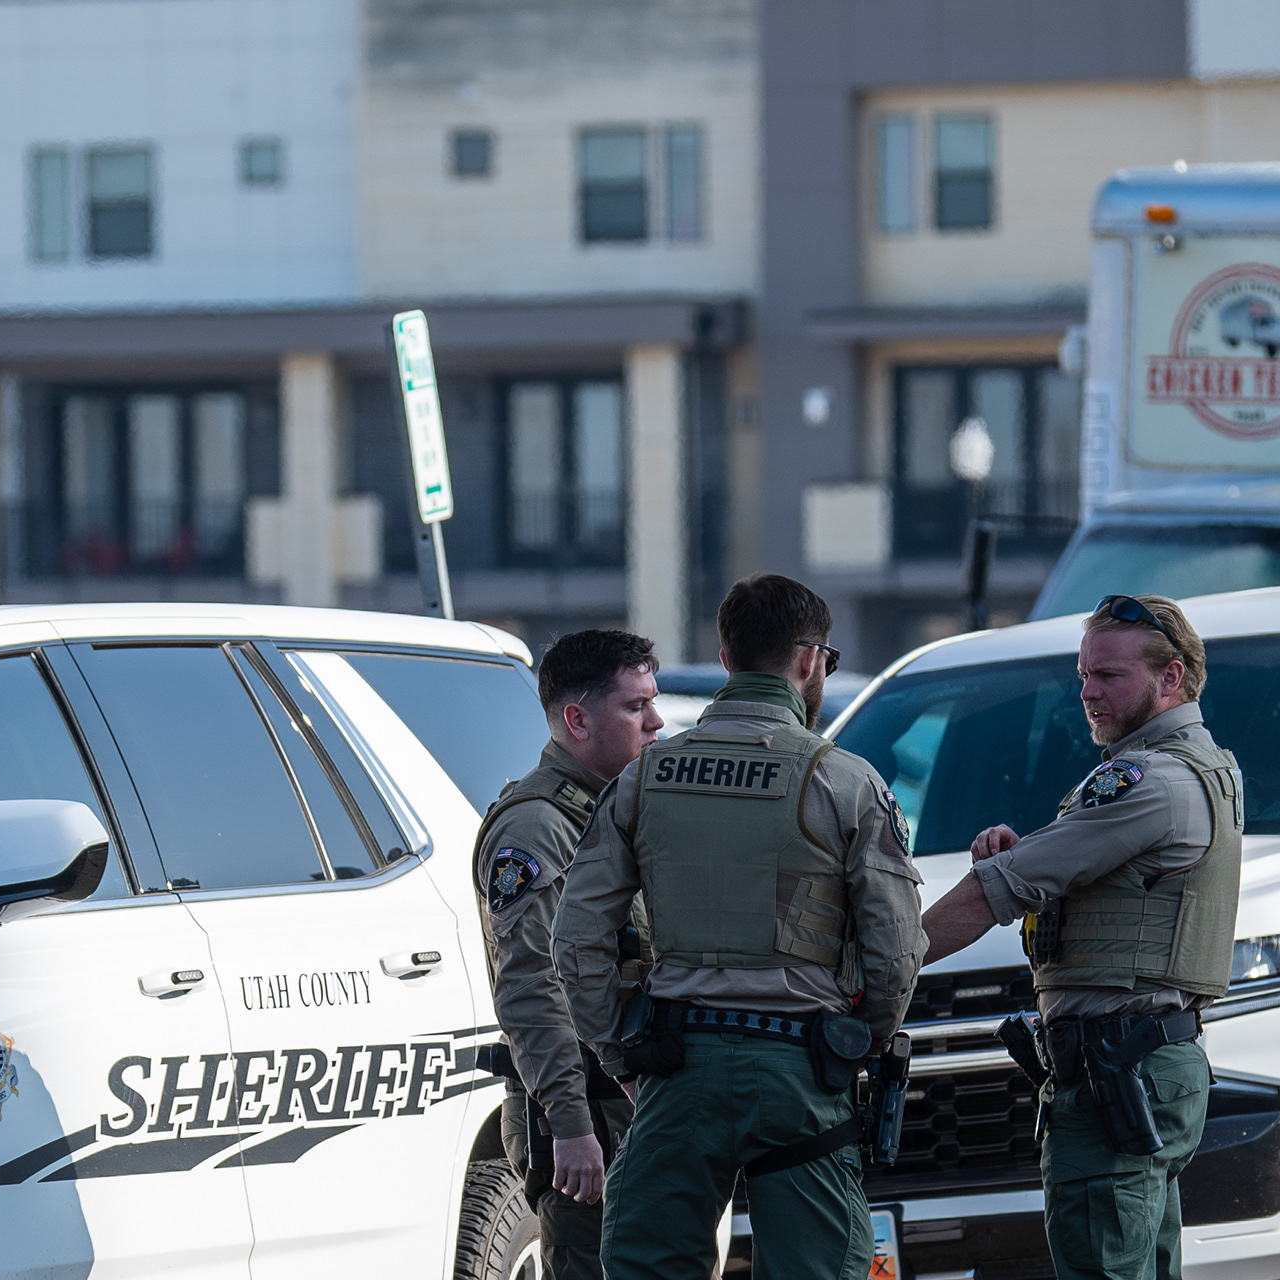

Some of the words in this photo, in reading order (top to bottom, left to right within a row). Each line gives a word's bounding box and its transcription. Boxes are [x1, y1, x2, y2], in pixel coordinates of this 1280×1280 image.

[655, 756, 781, 789] SHERIFF
[240, 974, 291, 1011] UTAH
[298, 970, 372, 1008] COUNTY
[100, 1042, 454, 1138] SHERIFF
